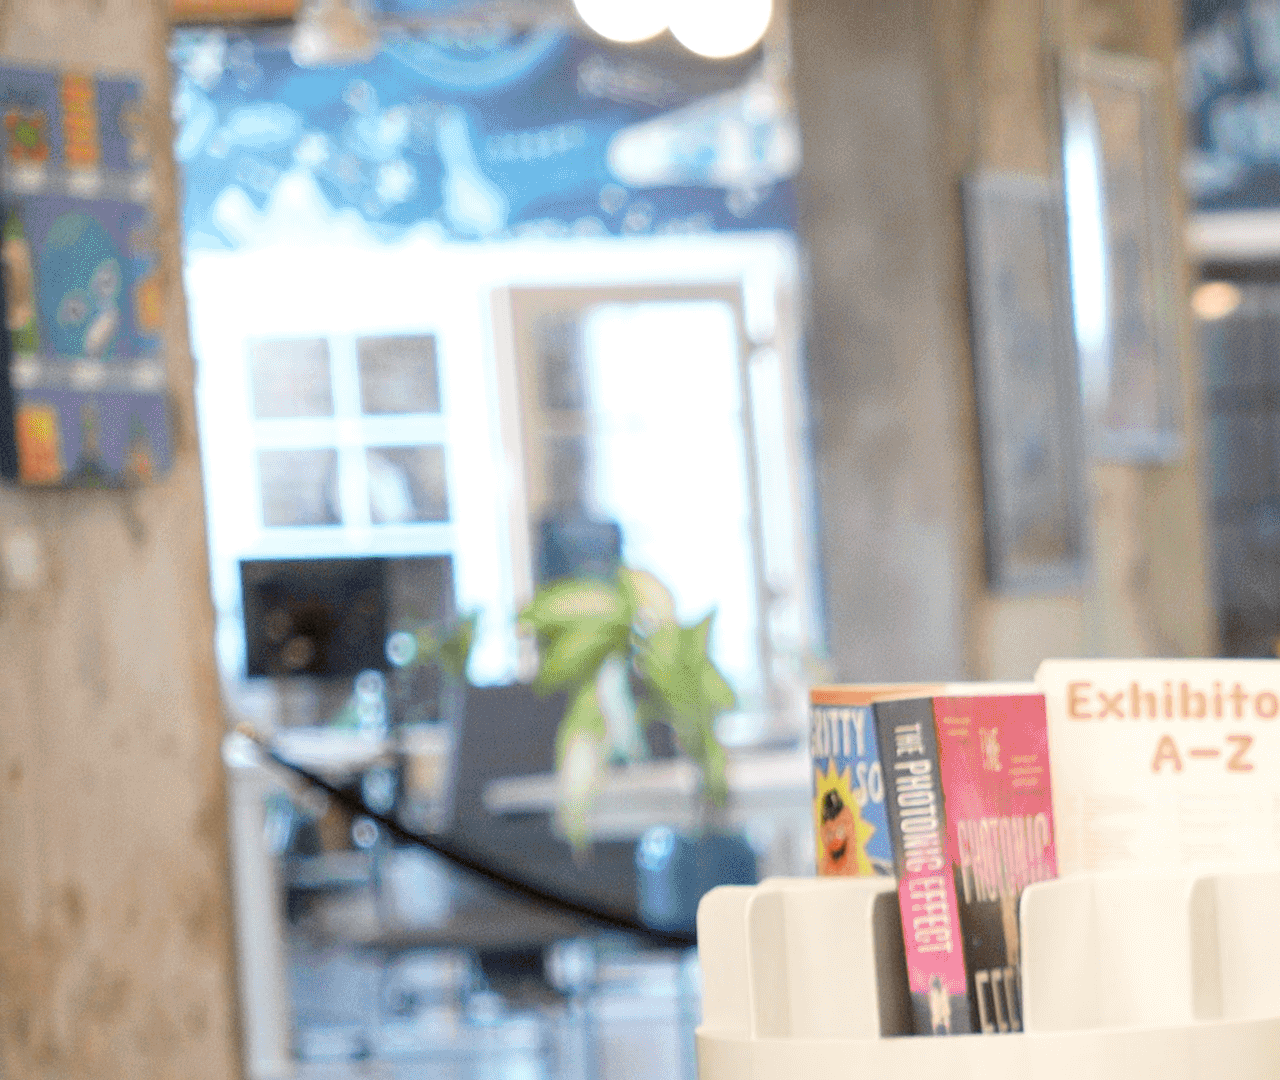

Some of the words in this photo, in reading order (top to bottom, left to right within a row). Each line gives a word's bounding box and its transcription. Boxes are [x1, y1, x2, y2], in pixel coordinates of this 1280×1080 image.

[895, 723, 923, 757] THE
[895, 759, 946, 873] PHOTONIC
[909, 876, 953, 953] EFFECT
